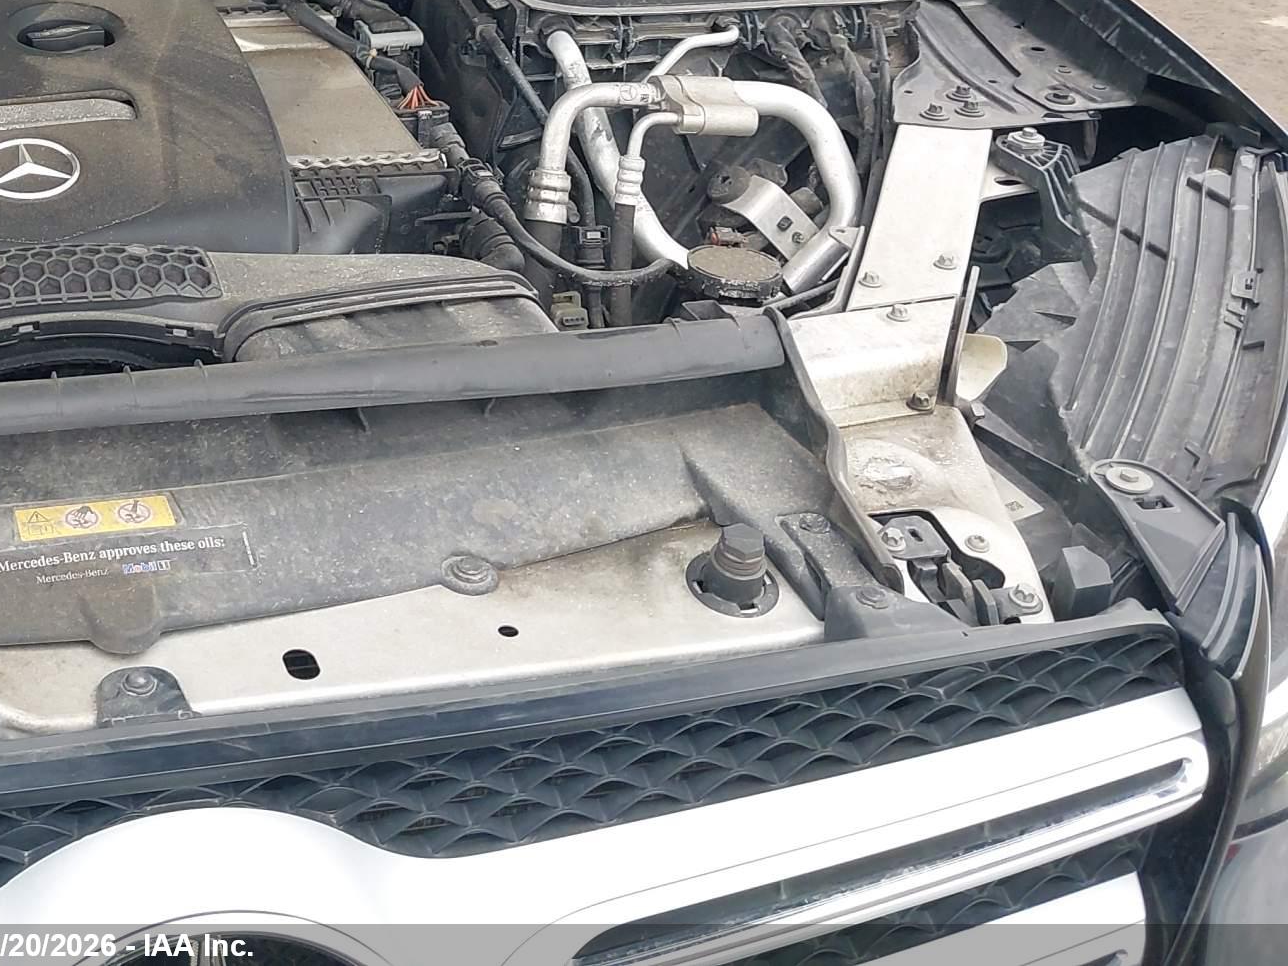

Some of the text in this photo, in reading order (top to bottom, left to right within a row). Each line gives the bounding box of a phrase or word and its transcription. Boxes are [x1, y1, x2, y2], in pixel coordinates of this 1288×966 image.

[99, 543, 158, 561] approves
[160, 540, 195, 553] these
[198, 536, 226, 549] oils:
[122, 562, 157, 575] Mobil
[36, 569, 108, 585] Mercedes-Benz
